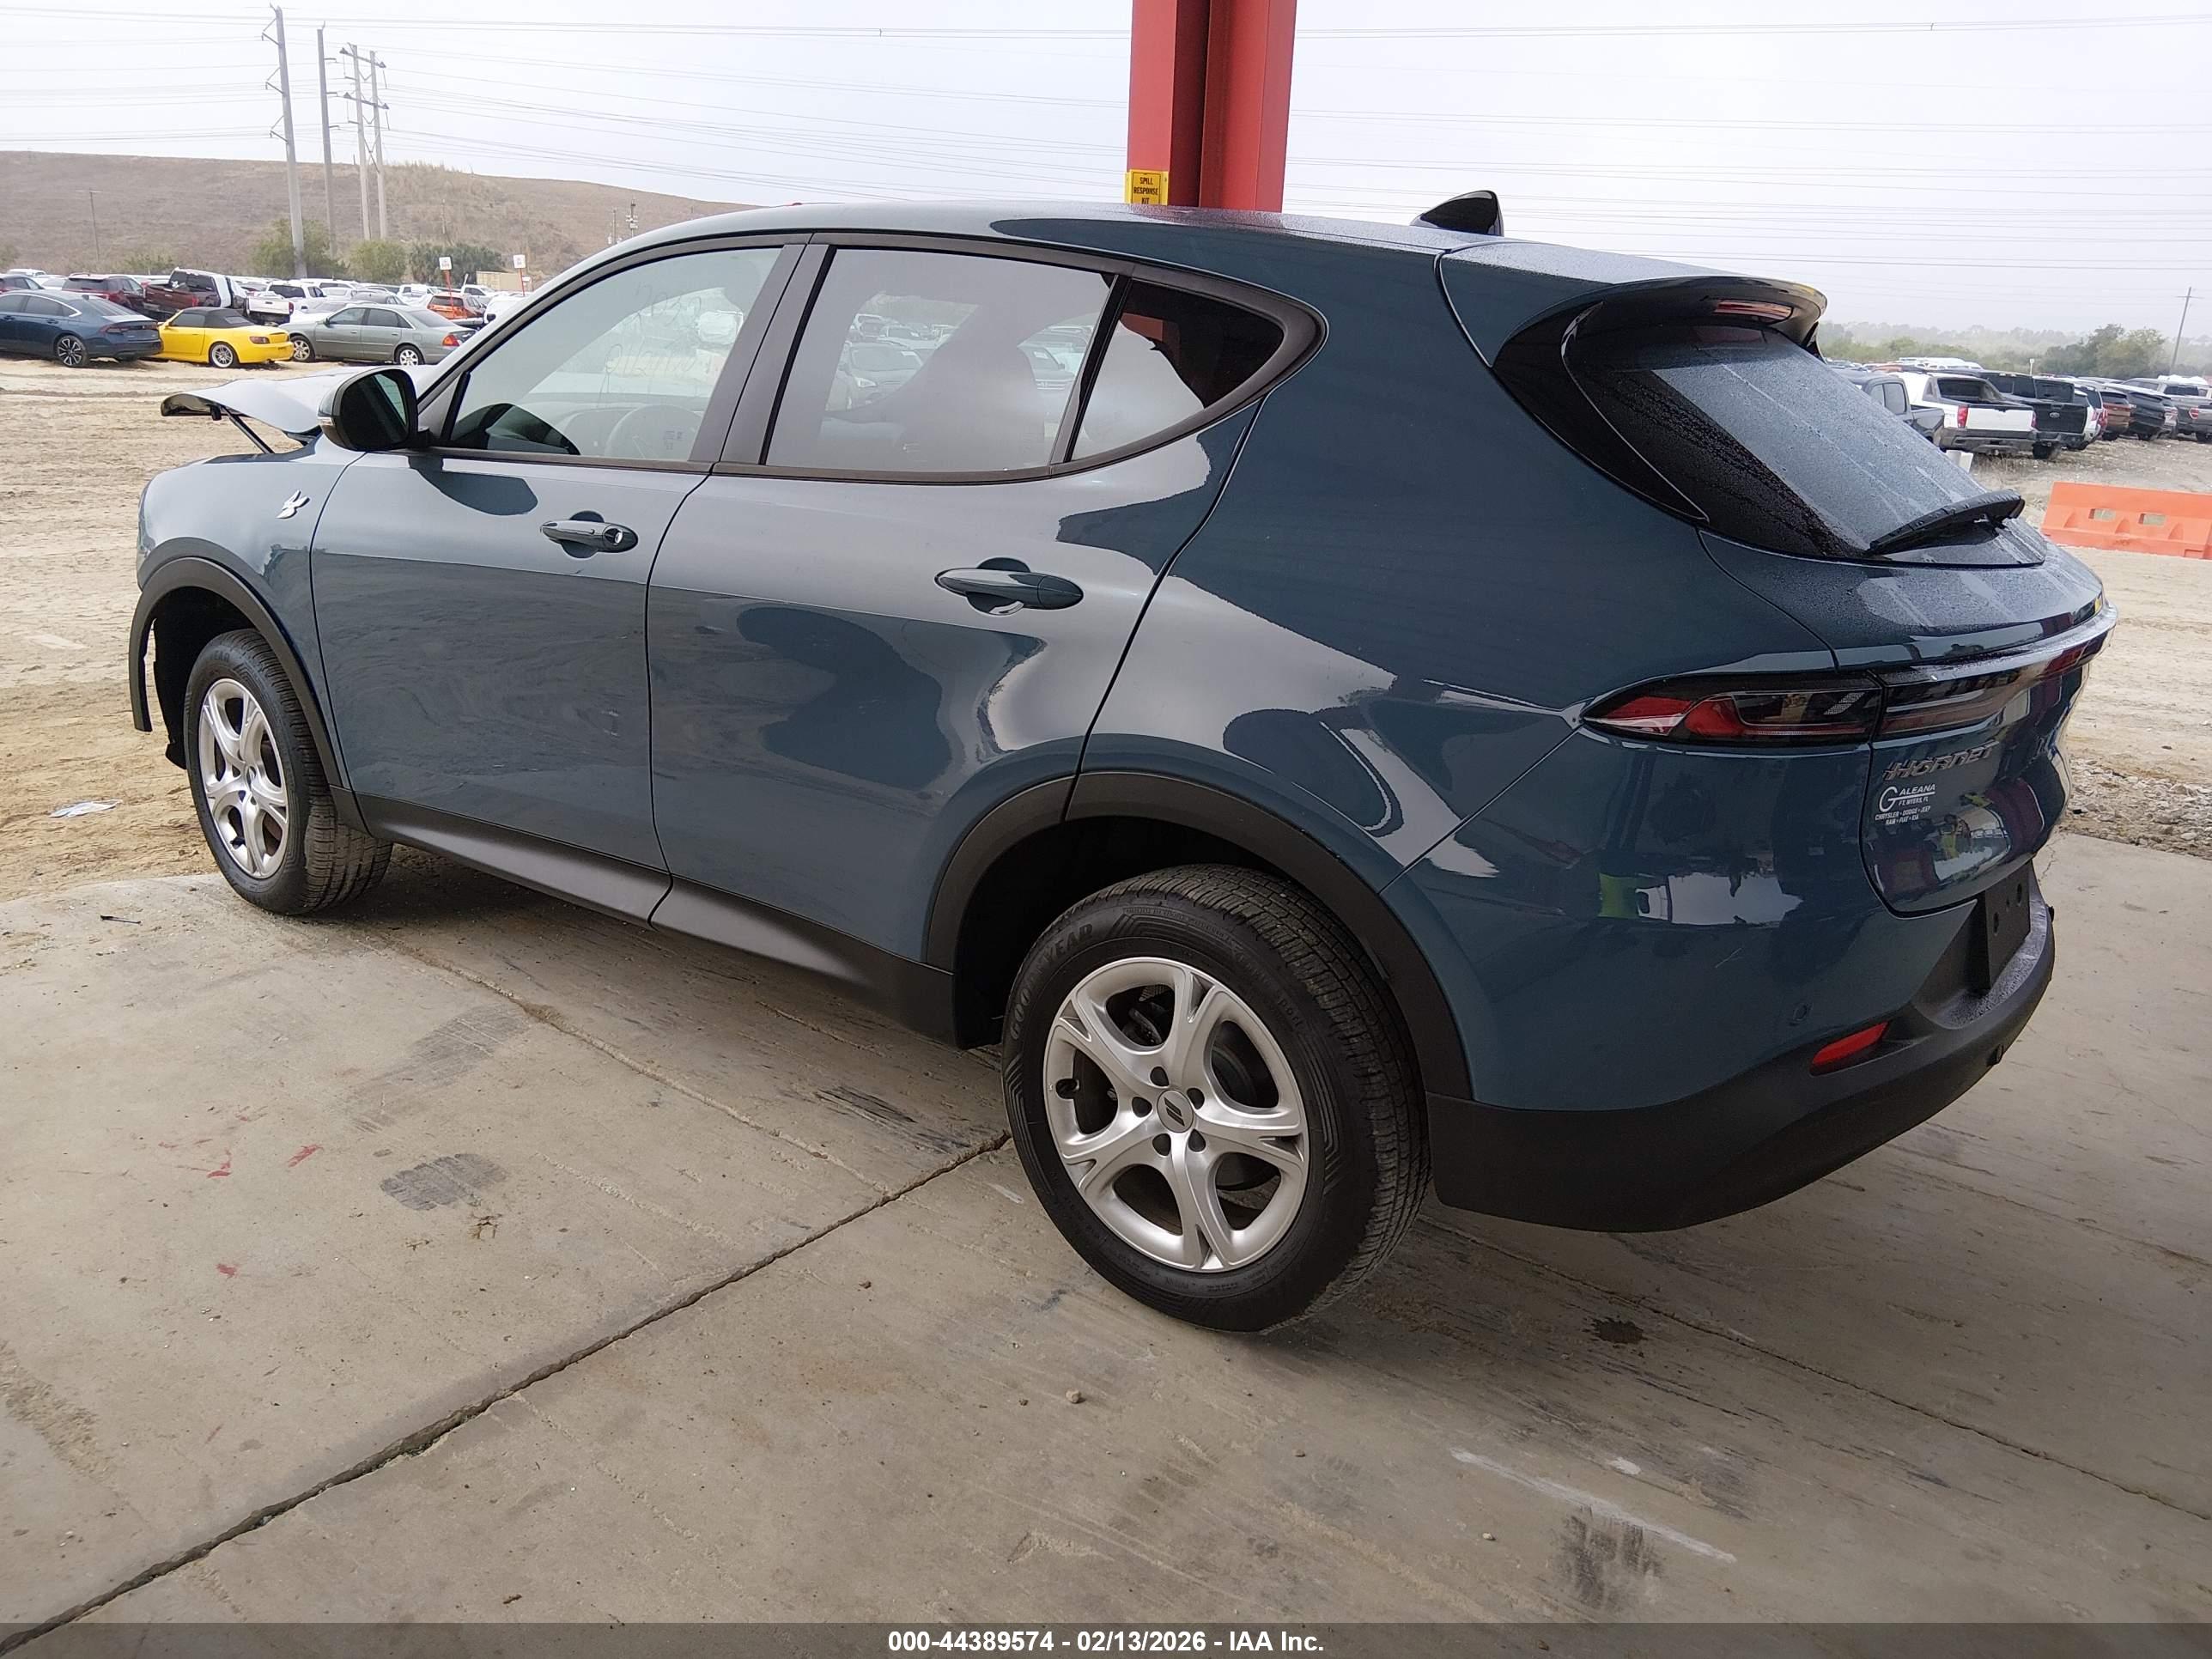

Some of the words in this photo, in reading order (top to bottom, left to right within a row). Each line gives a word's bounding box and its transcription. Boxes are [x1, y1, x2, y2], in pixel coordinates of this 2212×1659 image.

[1133, 186, 1158, 195] RESPONSE
[1879, 783, 1936, 811] GALEANA
[1875, 811, 1899, 820] CHRYSLER
